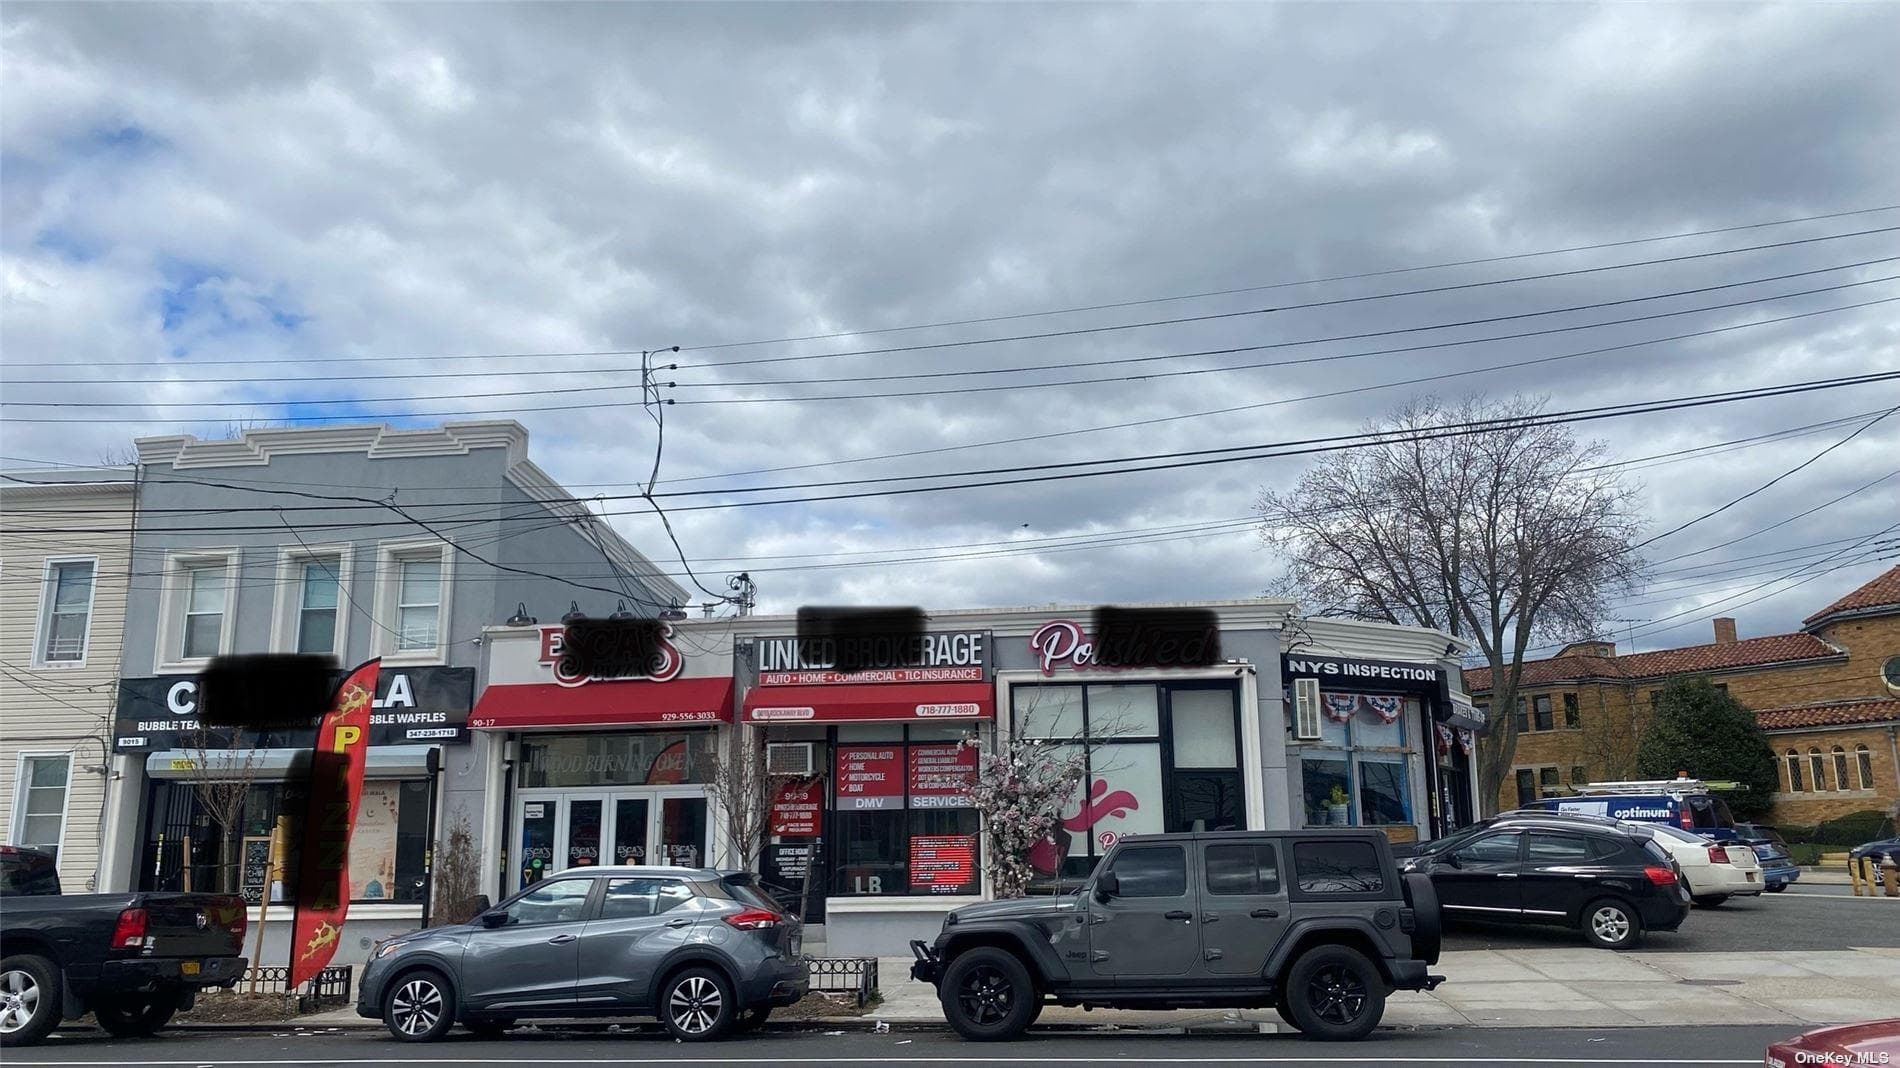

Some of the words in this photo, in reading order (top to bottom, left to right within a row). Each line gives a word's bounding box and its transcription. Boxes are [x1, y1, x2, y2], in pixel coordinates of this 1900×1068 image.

[1289, 659, 1339, 675] NYS
[1343, 663, 1437, 682] INSPECTION
[766, 674, 791, 684] AUTO
[798, 673, 827, 684] HOME
[835, 670, 897, 683] COMMERCIAL
[904, 669, 921, 680] TLC
[922, 668, 977, 680] INSURANCE
[921, 704, 975, 715] 718-777-1880
[397, 712, 447, 723] WAFFLES
[662, 711, 716, 721] 929-556-3033
[137, 721, 179, 732] BUBBLE
[180, 720, 201, 731] TEA
[473, 718, 496, 727] 90-17
[849, 752, 878, 760] PERSONAL
[878, 751, 894, 760] AUTO
[849, 762, 865, 771] HOME
[848, 783, 864, 792] BOAT
[855, 798, 884, 808] DMV
[1614, 806, 1670, 819] optimum
[855, 876, 882, 894] LB
[1065, 950, 1087, 960] Jeep
